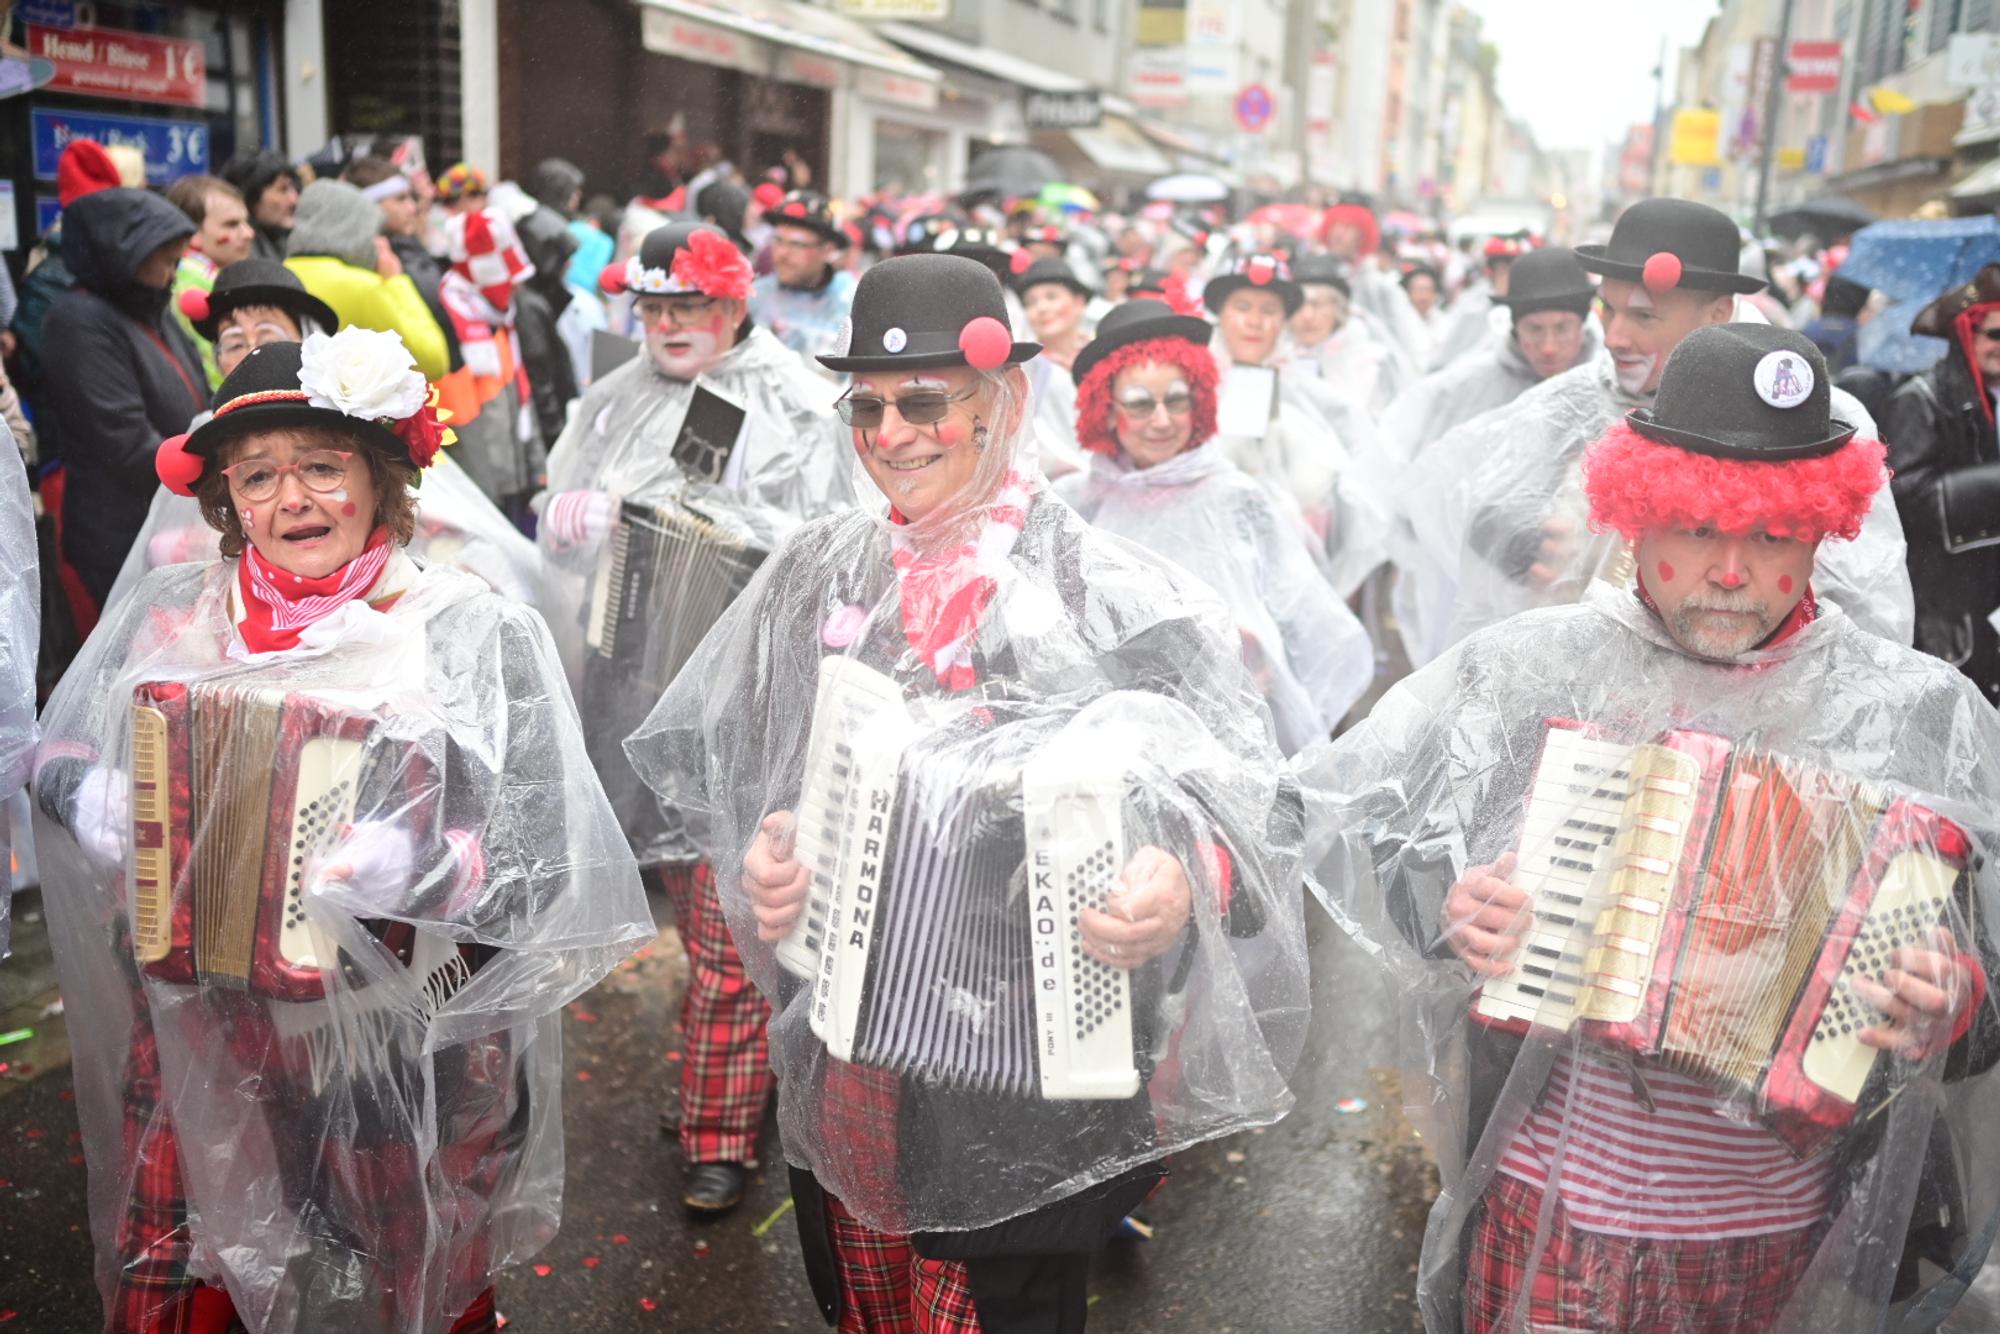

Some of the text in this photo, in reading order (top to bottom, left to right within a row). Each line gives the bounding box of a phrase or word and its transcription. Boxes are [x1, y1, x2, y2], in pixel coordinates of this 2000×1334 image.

[43, 33, 94, 63] Hemd
[849, 788, 891, 950] HARMONA
[1046, 1029, 1055, 1056] PONY
